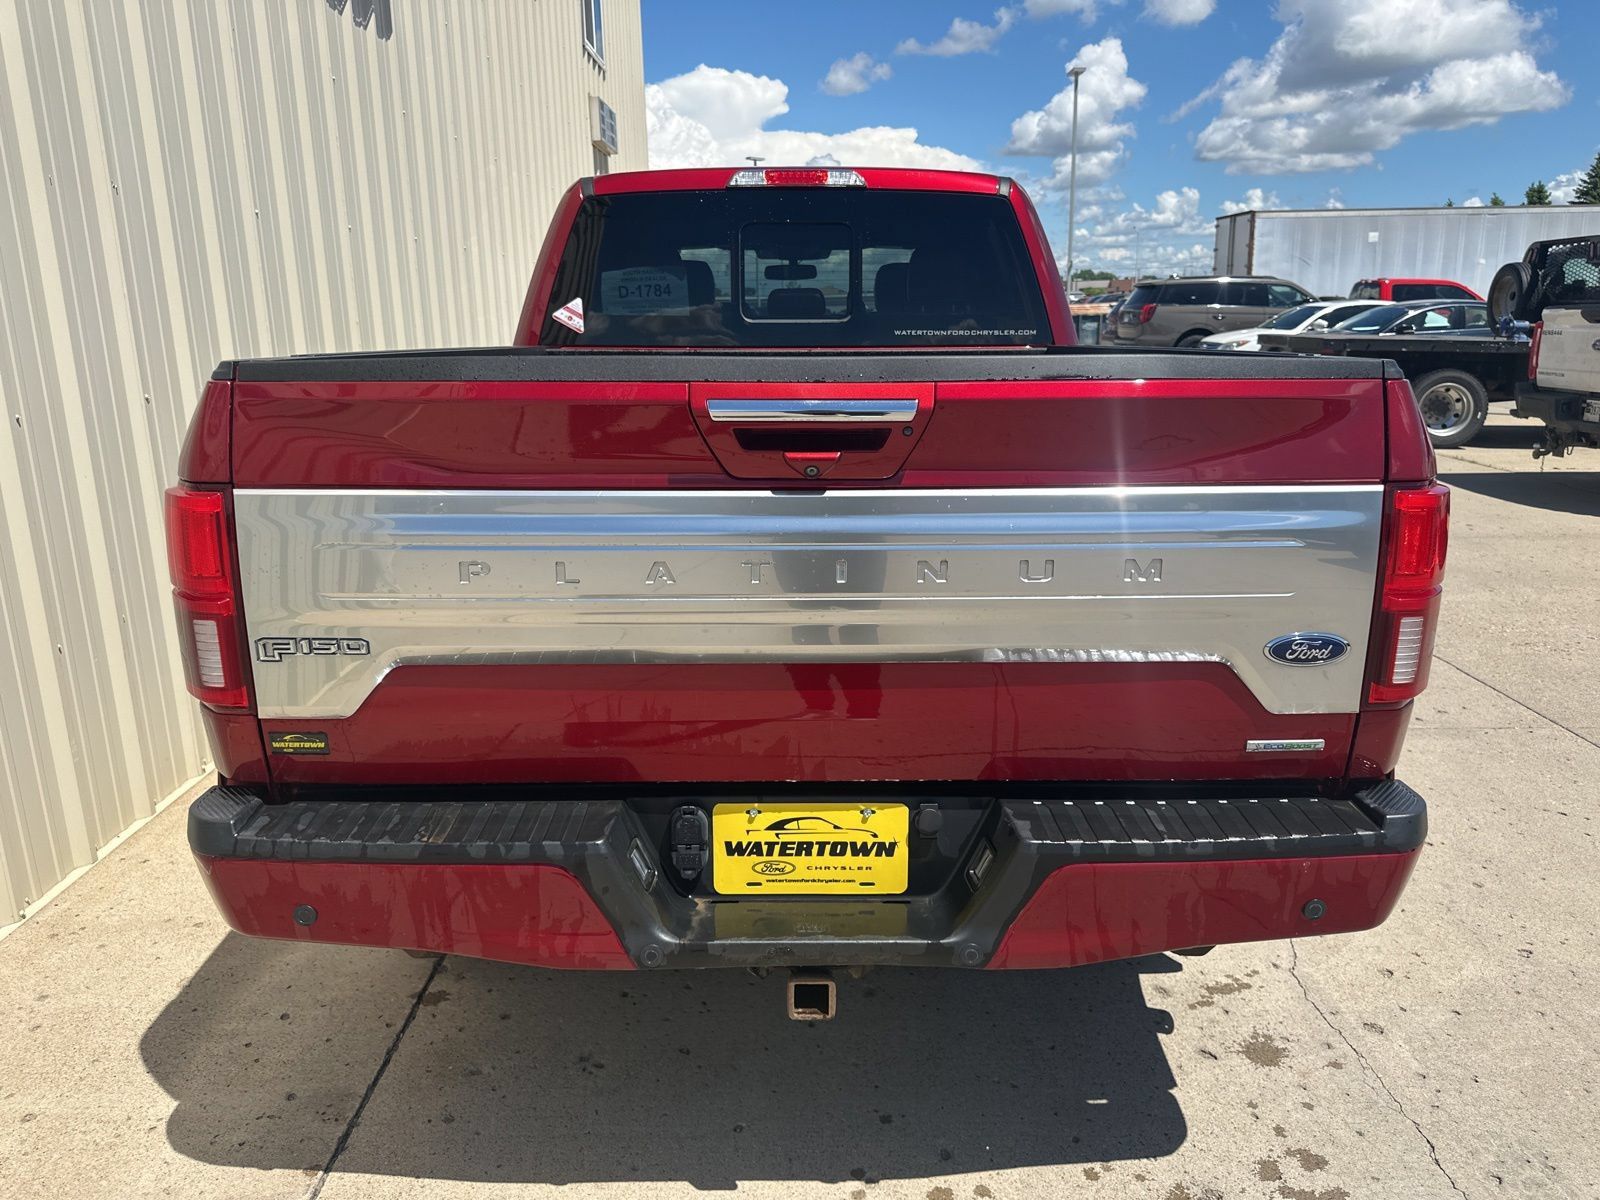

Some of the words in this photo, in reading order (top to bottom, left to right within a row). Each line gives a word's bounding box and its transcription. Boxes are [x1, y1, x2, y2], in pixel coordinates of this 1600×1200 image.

[618, 283, 673, 299] D-1784
[458, 557, 1163, 585] PLATINUM
[1285, 639, 1333, 660] Ford
[271, 741, 325, 749] WATERTOWN
[724, 840, 897, 858] WATERTOWN
